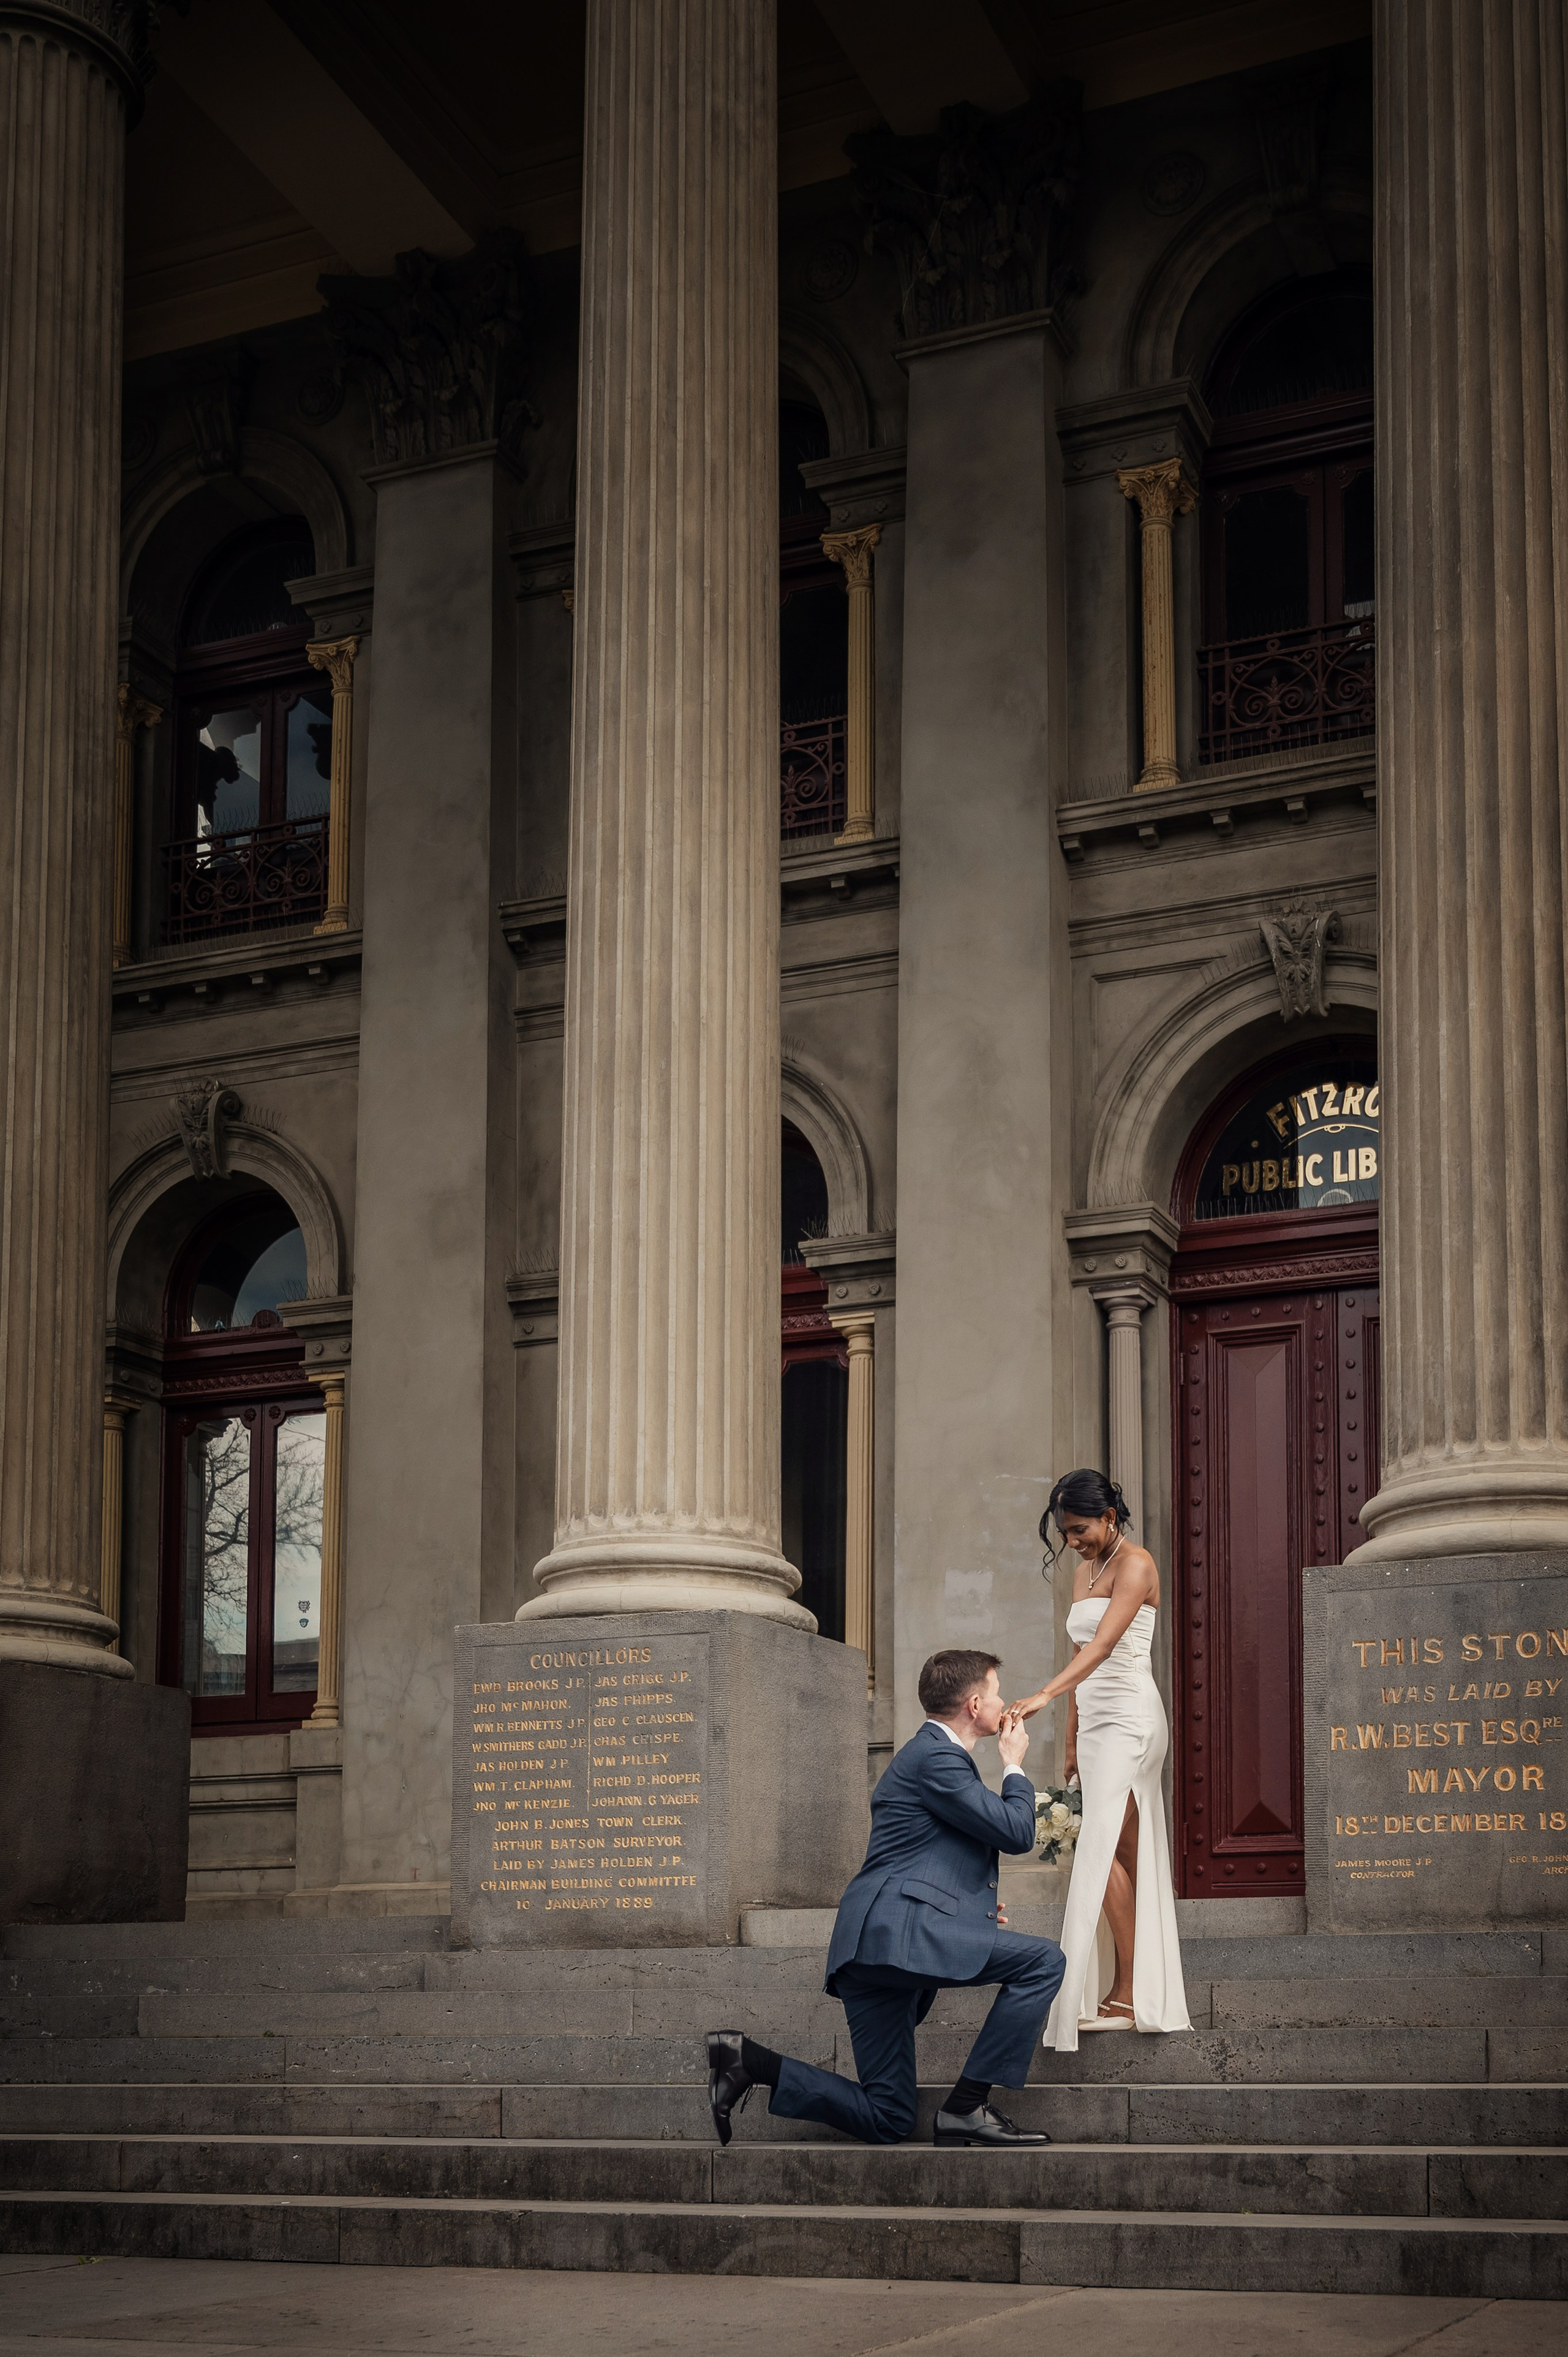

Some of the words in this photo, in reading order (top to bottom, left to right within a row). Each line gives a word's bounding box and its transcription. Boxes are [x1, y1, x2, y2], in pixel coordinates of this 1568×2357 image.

[1223, 1154, 1324, 1196] PUBLIC
[1333, 1147, 1378, 1183] LIB
[1352, 1636, 1444, 1668] THIS
[1461, 1629, 1568, 1661] STON
[530, 1647, 652, 1670] COUNCILLORS
[473, 1682, 502, 1695] EWD
[507, 1679, 559, 1692] BROOKS
[595, 1675, 617, 1687] JAS
[623, 1673, 664, 1685] GRIGG
[1382, 1684, 1436, 1704] WAS
[1448, 1681, 1511, 1701] LAID
[1525, 1678, 1562, 1698] BY
[595, 1696, 617, 1707] JAS
[473, 1722, 494, 1733] WM
[594, 1716, 616, 1727] GEO
[538, 1738, 567, 1750] GADD
[594, 1735, 626, 1746] CHAS
[473, 1761, 495, 1772] JAS
[499, 1759, 544, 1771] HOLDEN
[594, 1776, 631, 1787] RICHD
[1408, 1765, 1545, 1794] MAYOR
[473, 1801, 496, 1812] JNO
[495, 1820, 529, 1831] JOHN
[597, 1817, 633, 1828] TOWN
[1384, 1813, 1528, 1834] DECEMBER
[1539, 1811, 1567, 1831] 18
[492, 1839, 543, 1851] ARTHUR
[551, 1837, 605, 1850] BATSON
[493, 1859, 522, 1871] LAID
[527, 1859, 545, 1869] BY
[551, 1857, 595, 1869] JAMES
[601, 1856, 653, 1868] HOLDEN
[1335, 1859, 1371, 1867] JAMES
[481, 1878, 546, 1890] CHAIRMAN
[551, 1877, 612, 1889] BUILDING
[619, 1875, 697, 1887] COMMITTEE
[516, 1900, 530, 1910] 10
[545, 1897, 610, 1910] JANUARY
[616, 1897, 653, 1908] 1889
